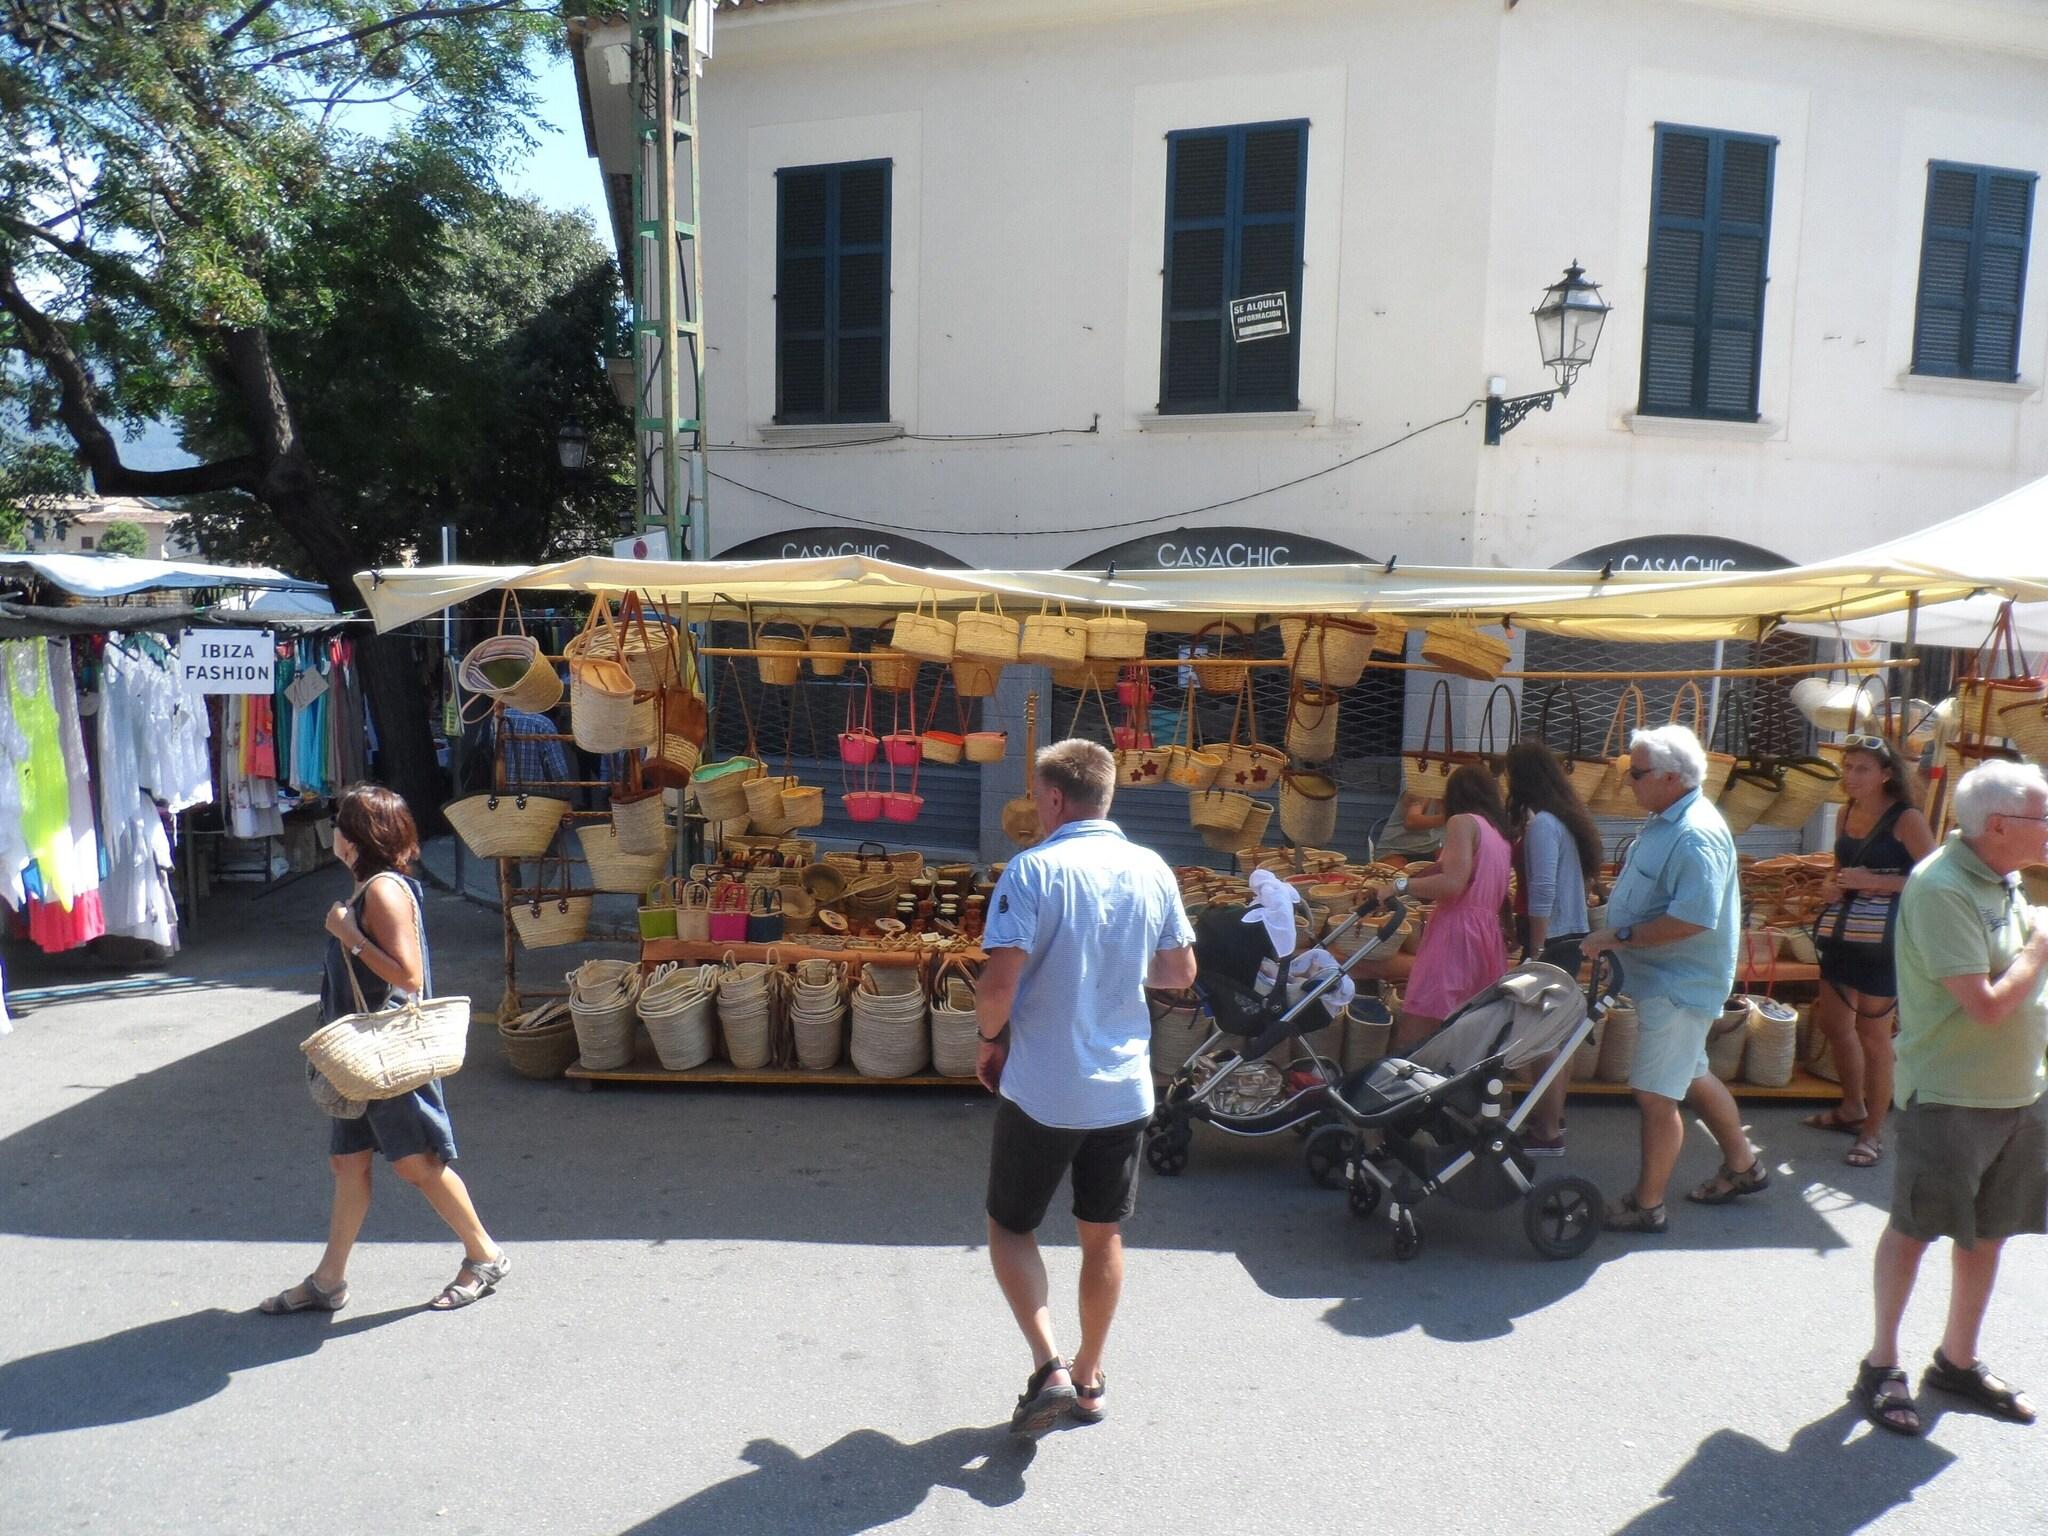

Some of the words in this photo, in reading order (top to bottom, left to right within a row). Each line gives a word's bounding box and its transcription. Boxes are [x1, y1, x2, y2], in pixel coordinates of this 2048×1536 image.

[1233, 305, 1245, 315] SE
[1246, 298, 1283, 312] ALQUILA
[201, 643, 255, 658] IBIZA
[185, 665, 269, 680] FASHION
